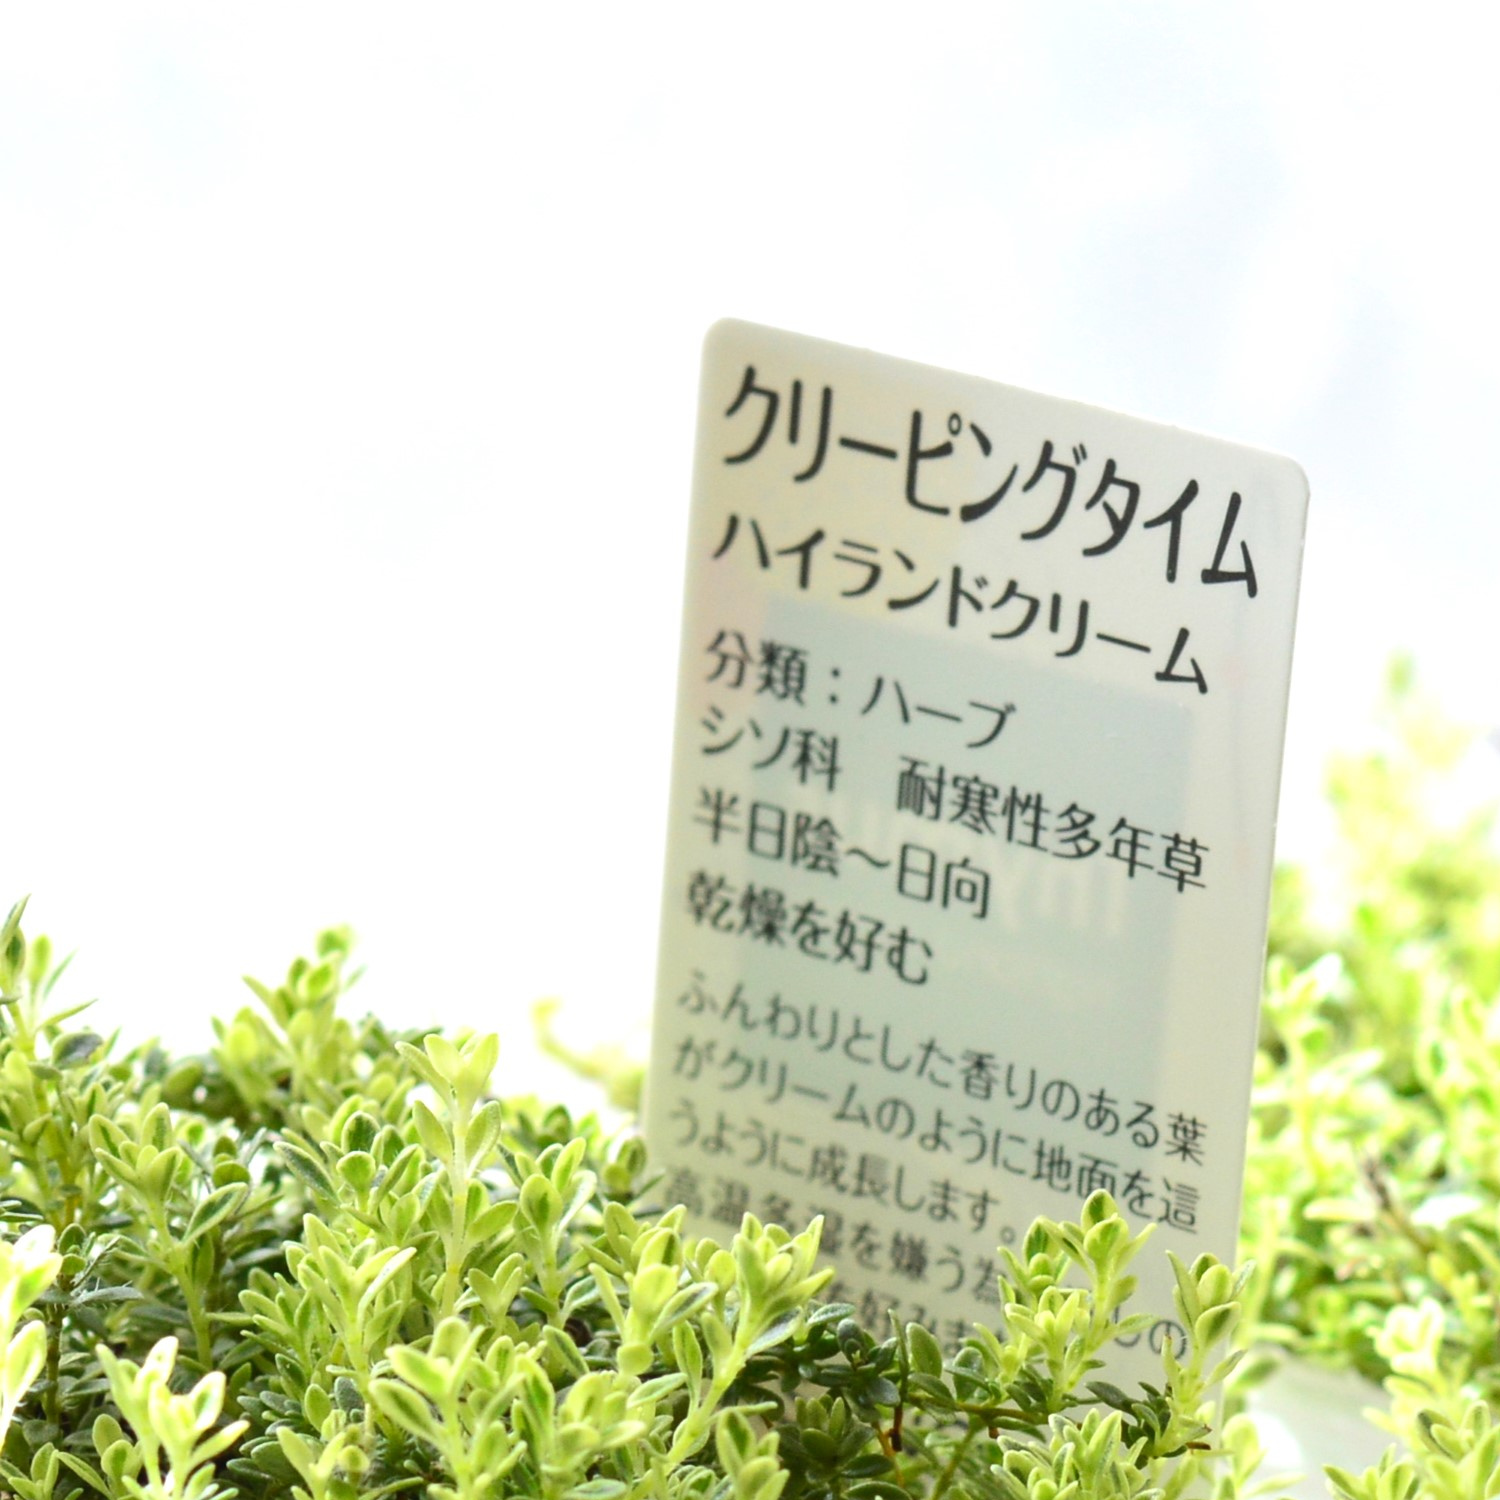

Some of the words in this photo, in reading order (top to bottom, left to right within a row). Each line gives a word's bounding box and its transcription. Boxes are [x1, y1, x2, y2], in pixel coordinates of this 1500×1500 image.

[724, 365, 1258, 598] クリーピングタイム
[706, 629, 1016, 749] 分類：ハーブ
[712, 513, 1209, 694] ハイランドクリーム
[701, 705, 841, 793] シソ科
[895, 756, 1210, 894] 耐寒性多年草
[686, 870, 934, 986] 乾燥を好む
[677, 968, 1208, 1168] ふんわりとした香りのある葉
[667, 1098, 1017, 1246] うように成長します。
